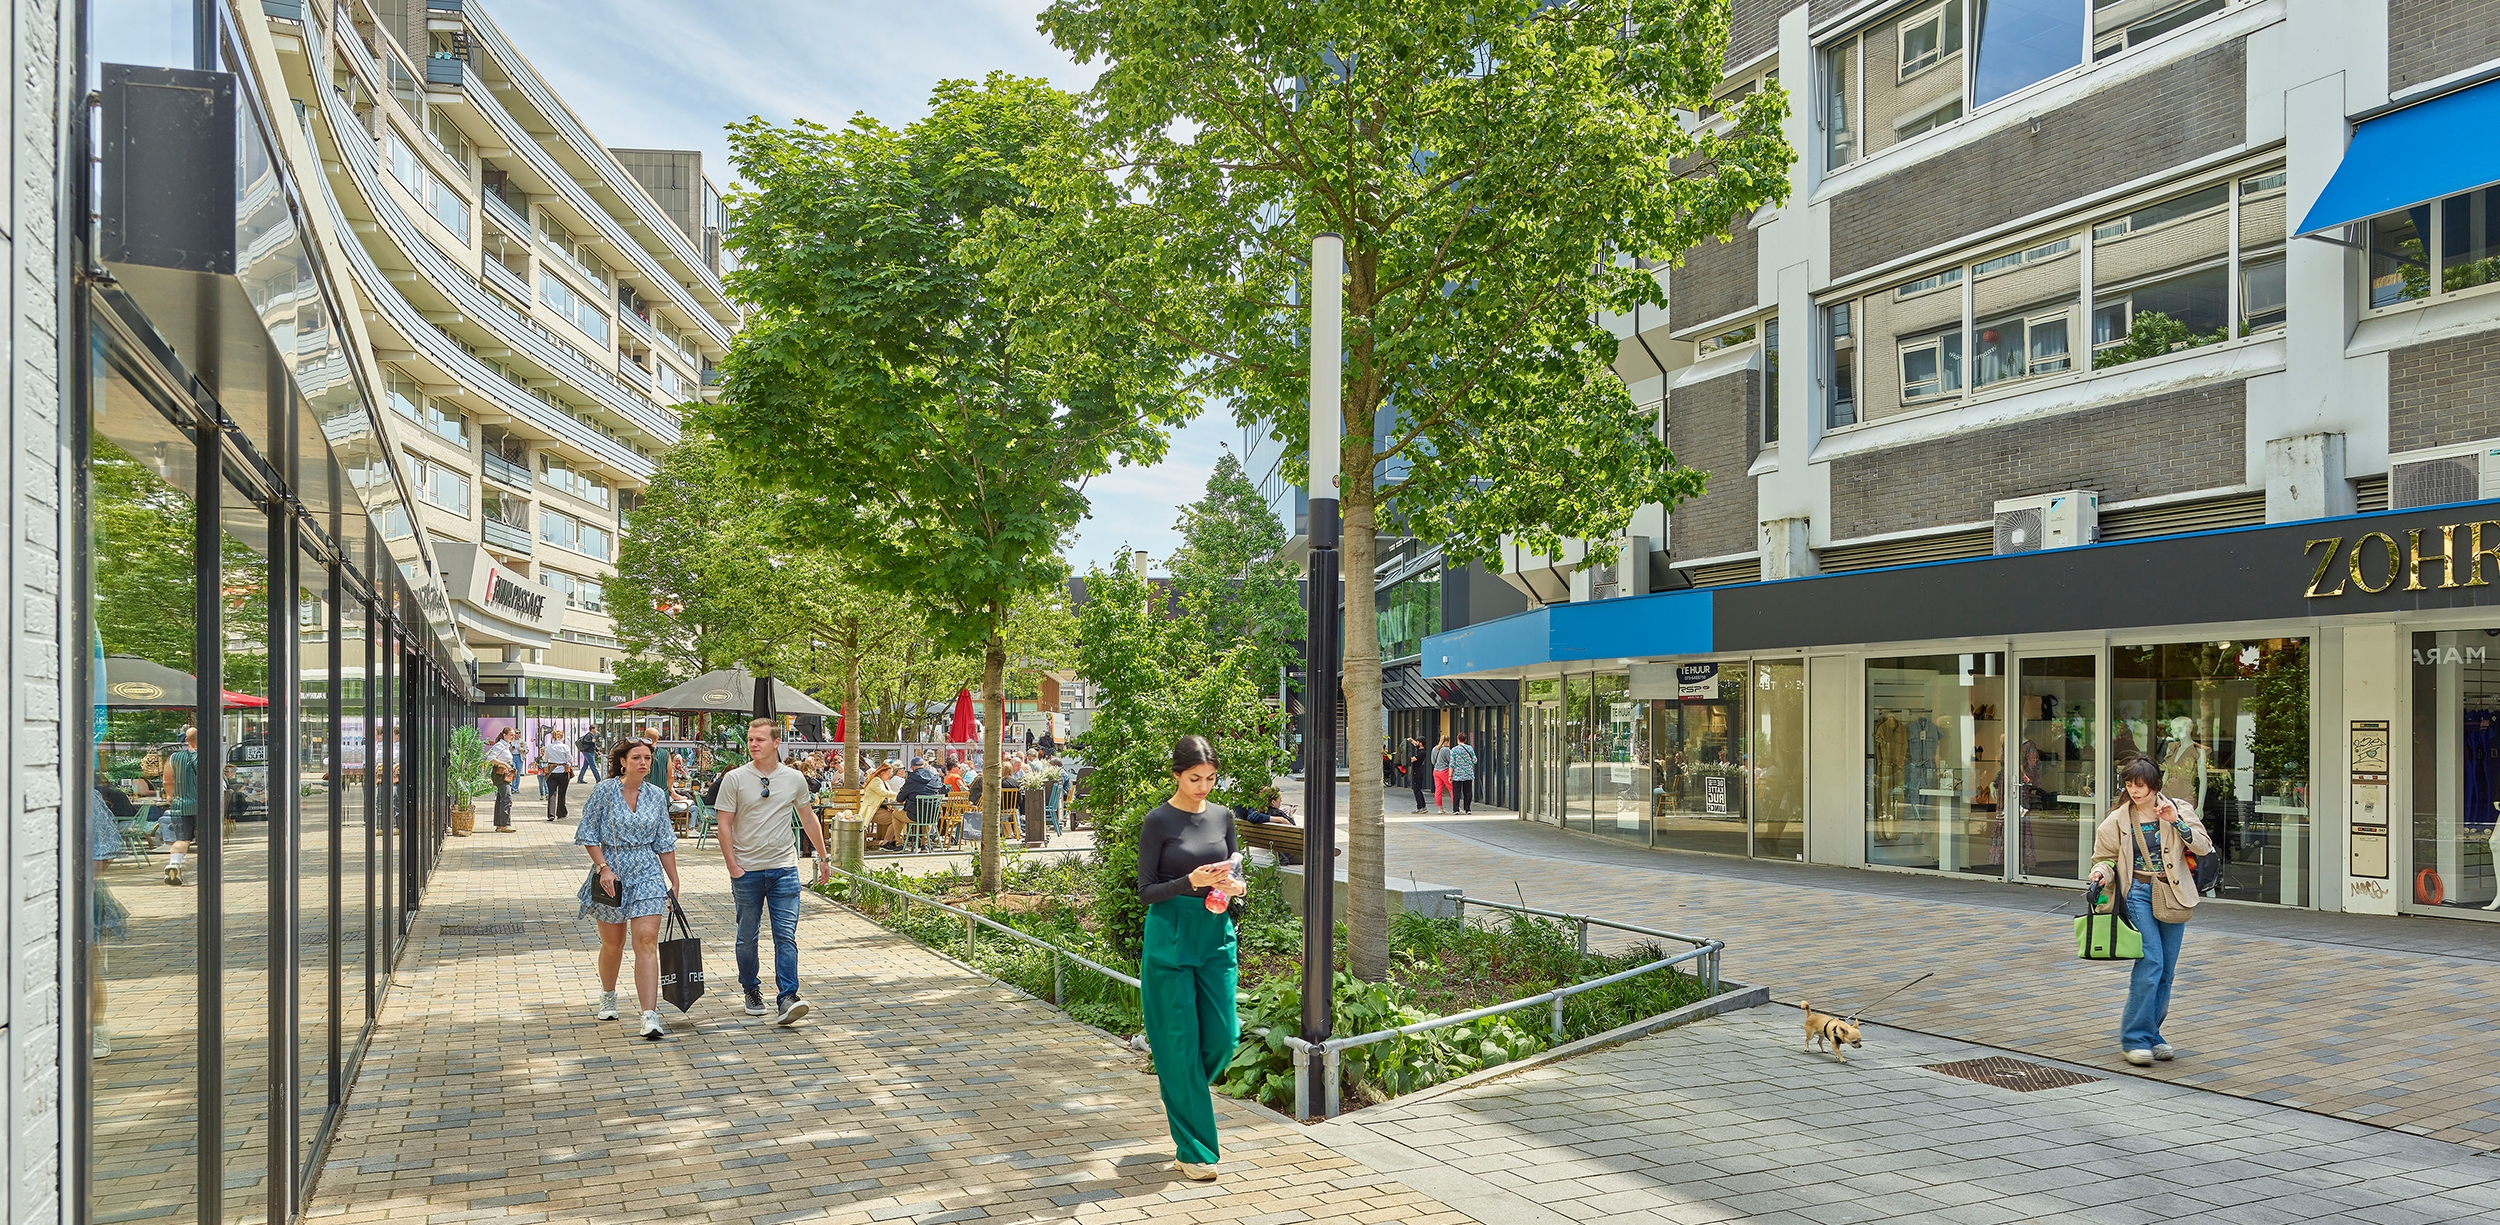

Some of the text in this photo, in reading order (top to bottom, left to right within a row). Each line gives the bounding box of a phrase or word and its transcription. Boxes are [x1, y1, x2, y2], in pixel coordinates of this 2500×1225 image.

[2303, 519, 2500, 598] ZOHR
[1690, 665, 1711, 674] HUUR
[1680, 685, 1702, 693] RSP
